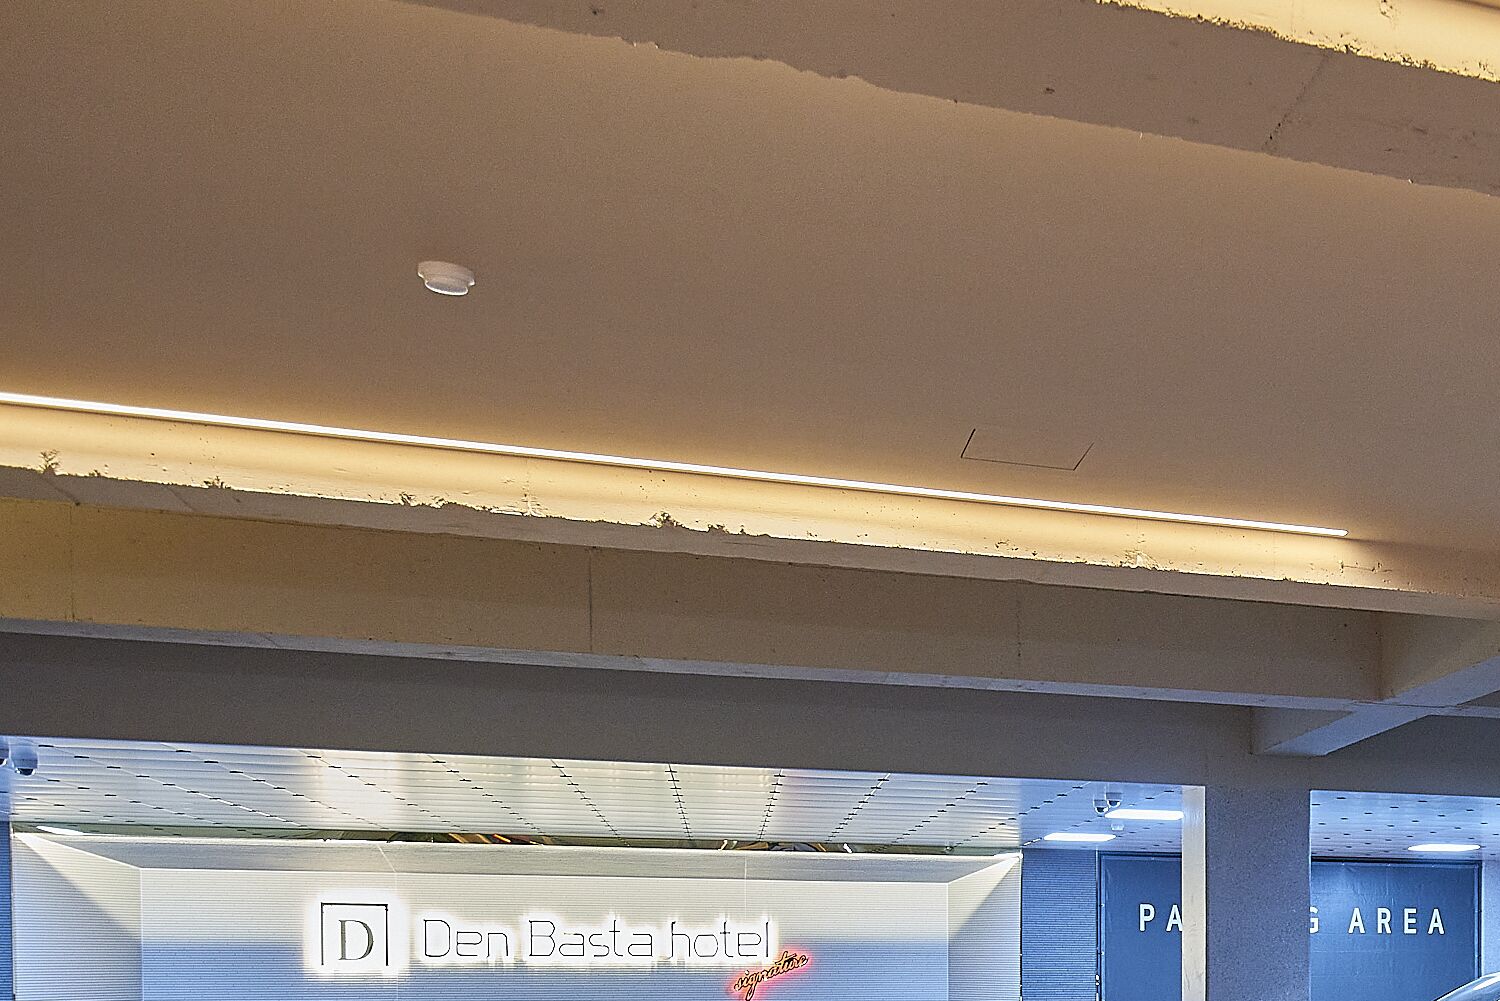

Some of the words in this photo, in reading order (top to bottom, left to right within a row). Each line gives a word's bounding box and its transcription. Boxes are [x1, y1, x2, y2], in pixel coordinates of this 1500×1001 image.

[1348, 907, 1446, 935] AREA
[423, 919, 509, 958] Den
[528, 919, 654, 958] Basta
[666, 920, 770, 960] hotel
